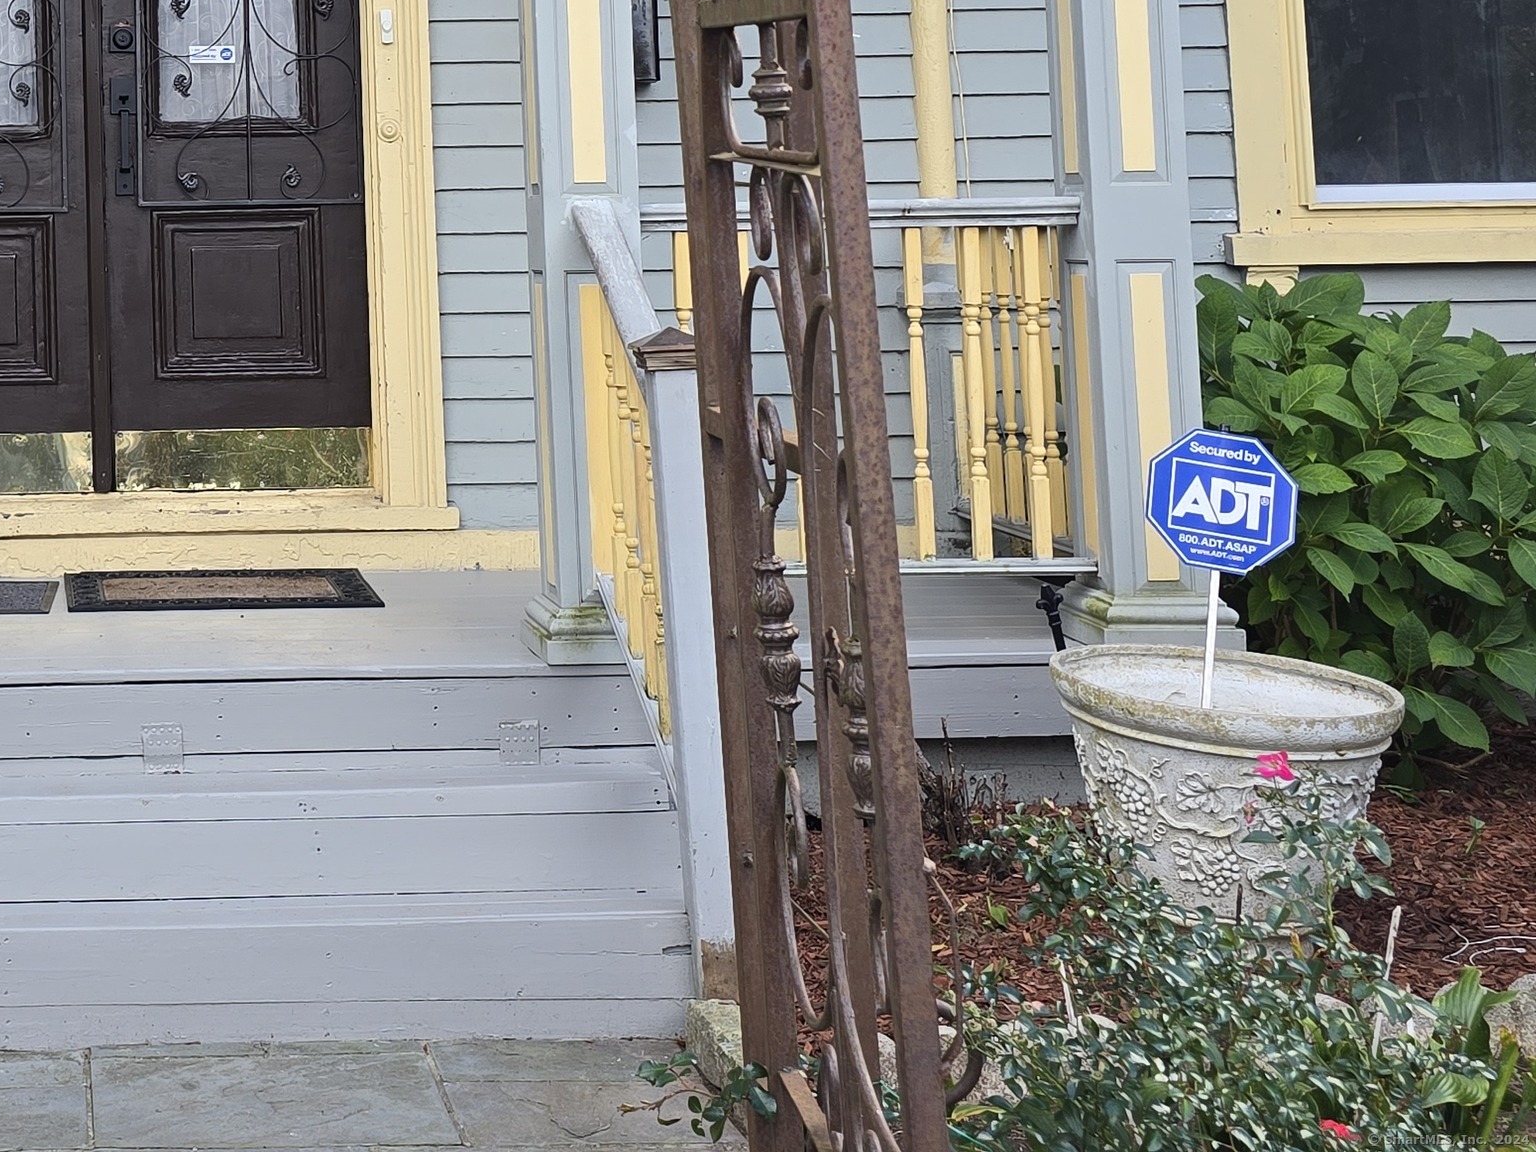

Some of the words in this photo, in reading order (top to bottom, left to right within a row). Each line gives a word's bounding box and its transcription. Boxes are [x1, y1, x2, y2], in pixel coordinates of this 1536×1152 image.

[1189, 441, 1243, 461] Secured
[1244, 449, 1261, 465] by
[1171, 475, 1271, 531] ADT
[1178, 533, 1257, 554] 800.ADT.ASAP
[1190, 548, 1245, 562] www.ADT.com
